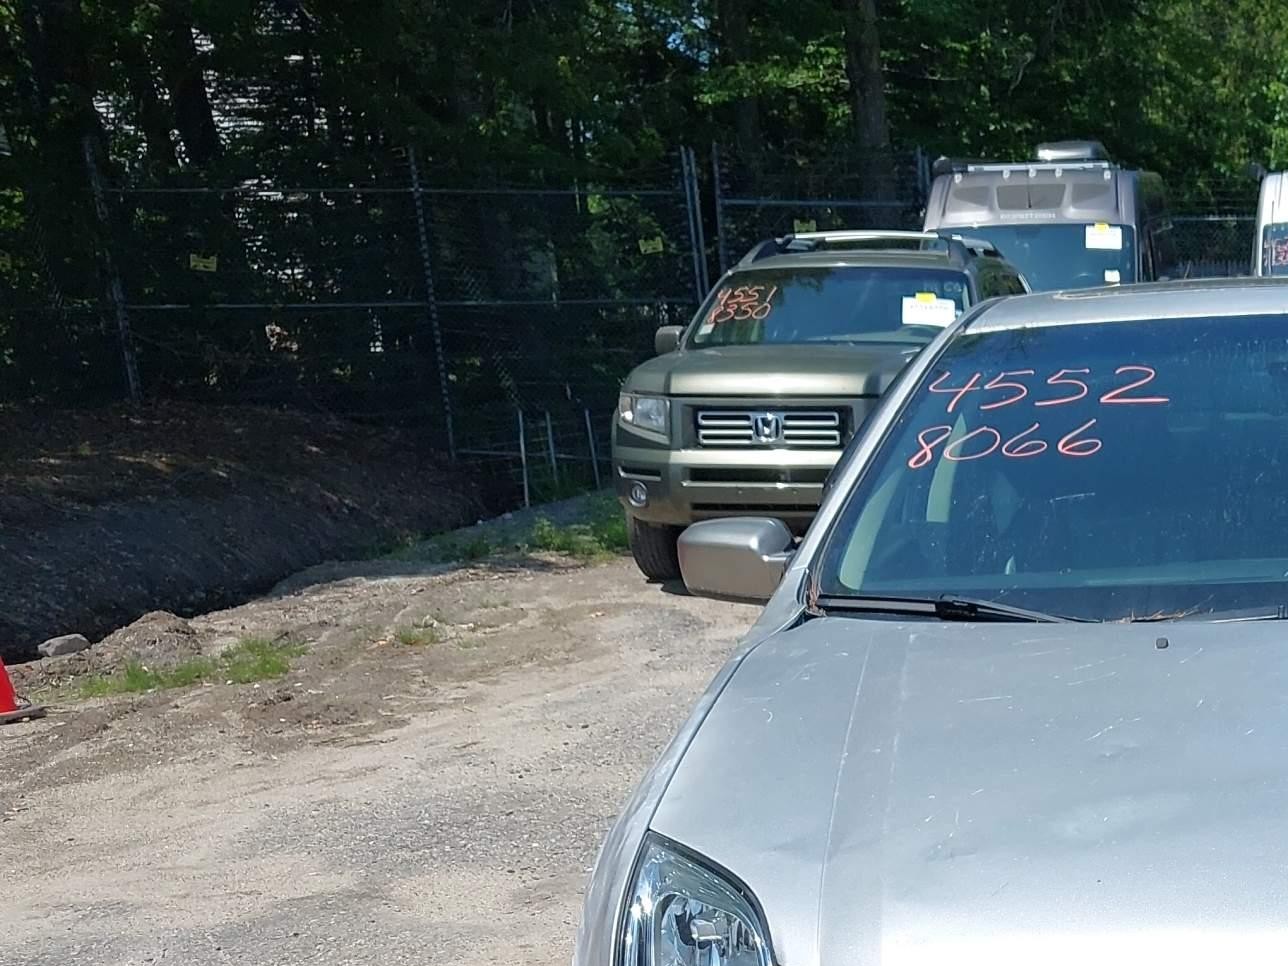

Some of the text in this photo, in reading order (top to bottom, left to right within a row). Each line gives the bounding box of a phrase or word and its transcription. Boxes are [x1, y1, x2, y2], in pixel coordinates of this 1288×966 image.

[707, 302, 771, 323] 8350
[717, 286, 778, 305] 4551
[928, 365, 1170, 413] 4552
[908, 418, 1102, 468] 8066
